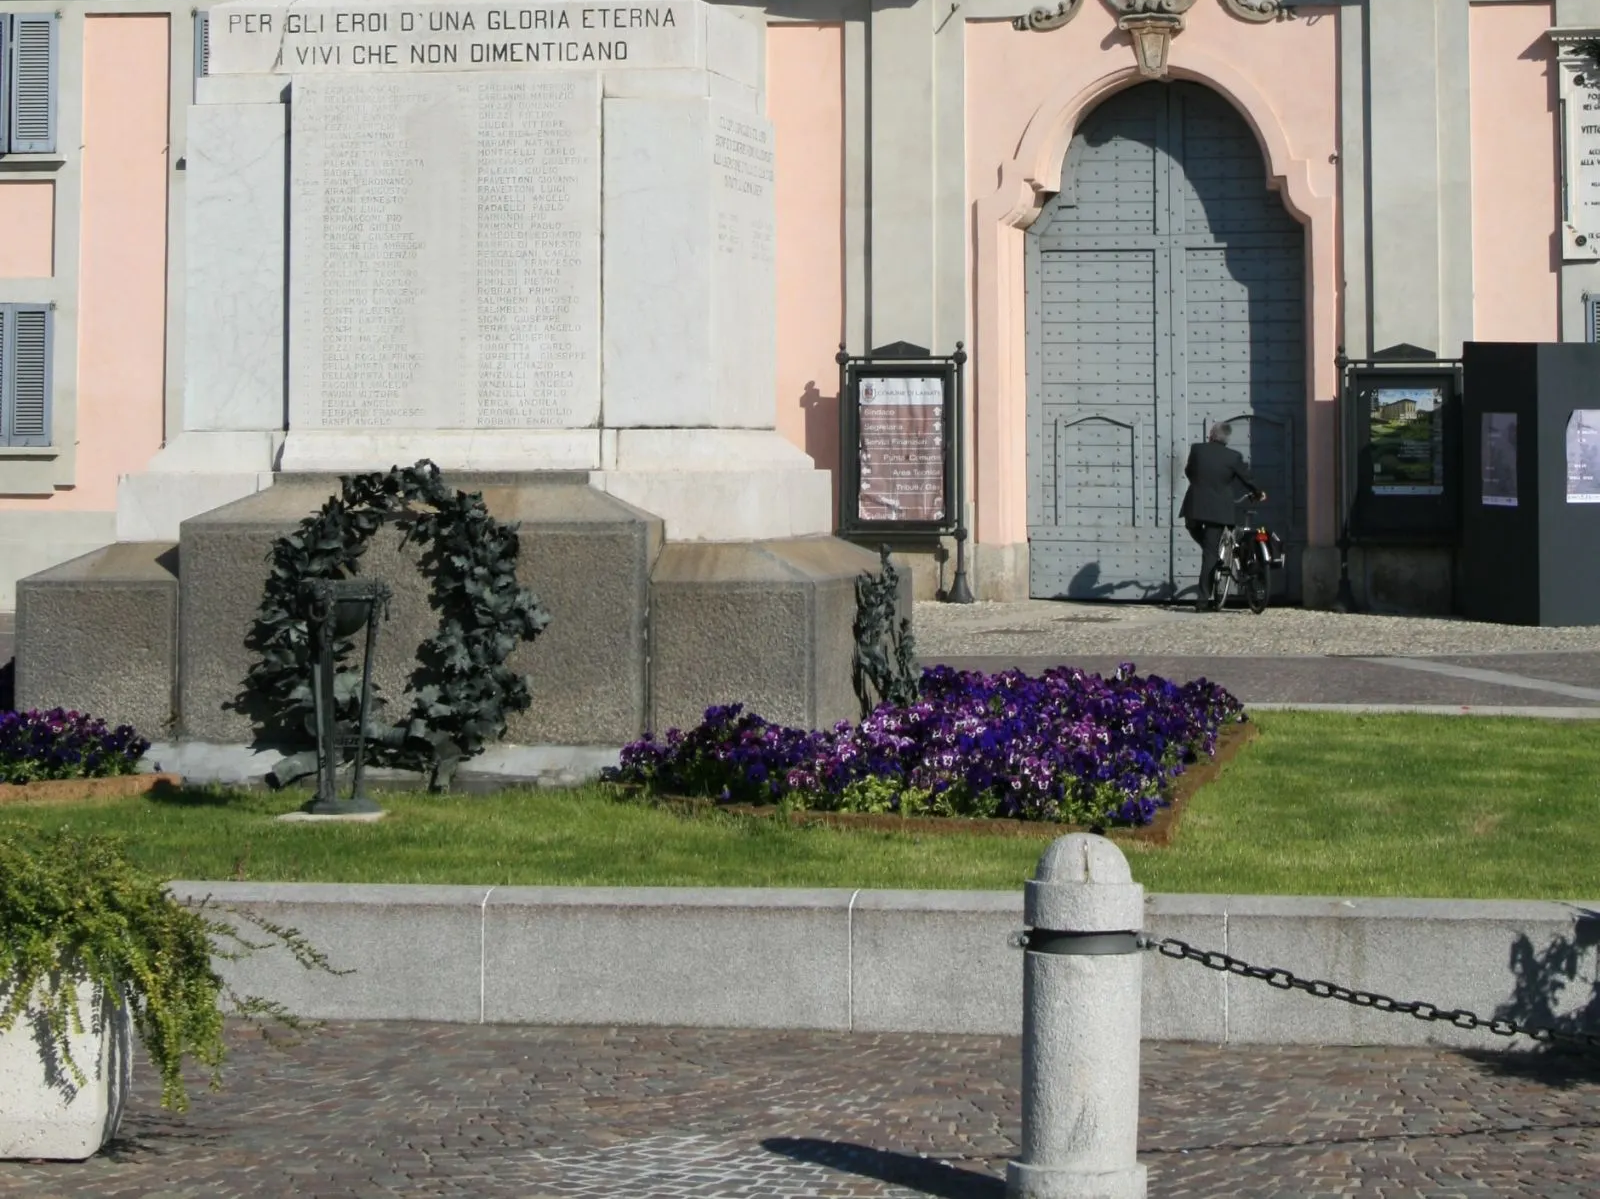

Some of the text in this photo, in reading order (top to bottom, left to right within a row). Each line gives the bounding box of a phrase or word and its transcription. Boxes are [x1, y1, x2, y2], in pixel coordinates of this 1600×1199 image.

[229, 14, 272, 33] PER
[287, 14, 323, 33] GLI
[336, 13, 387, 33] EROI
[488, 10, 570, 30] GLORIA
[582, 8, 676, 29] ETERNA
[296, 46, 341, 65] VIVI
[353, 45, 397, 64] CHE
[411, 44, 457, 64] NON
[471, 41, 628, 62] DIMENTICANO
